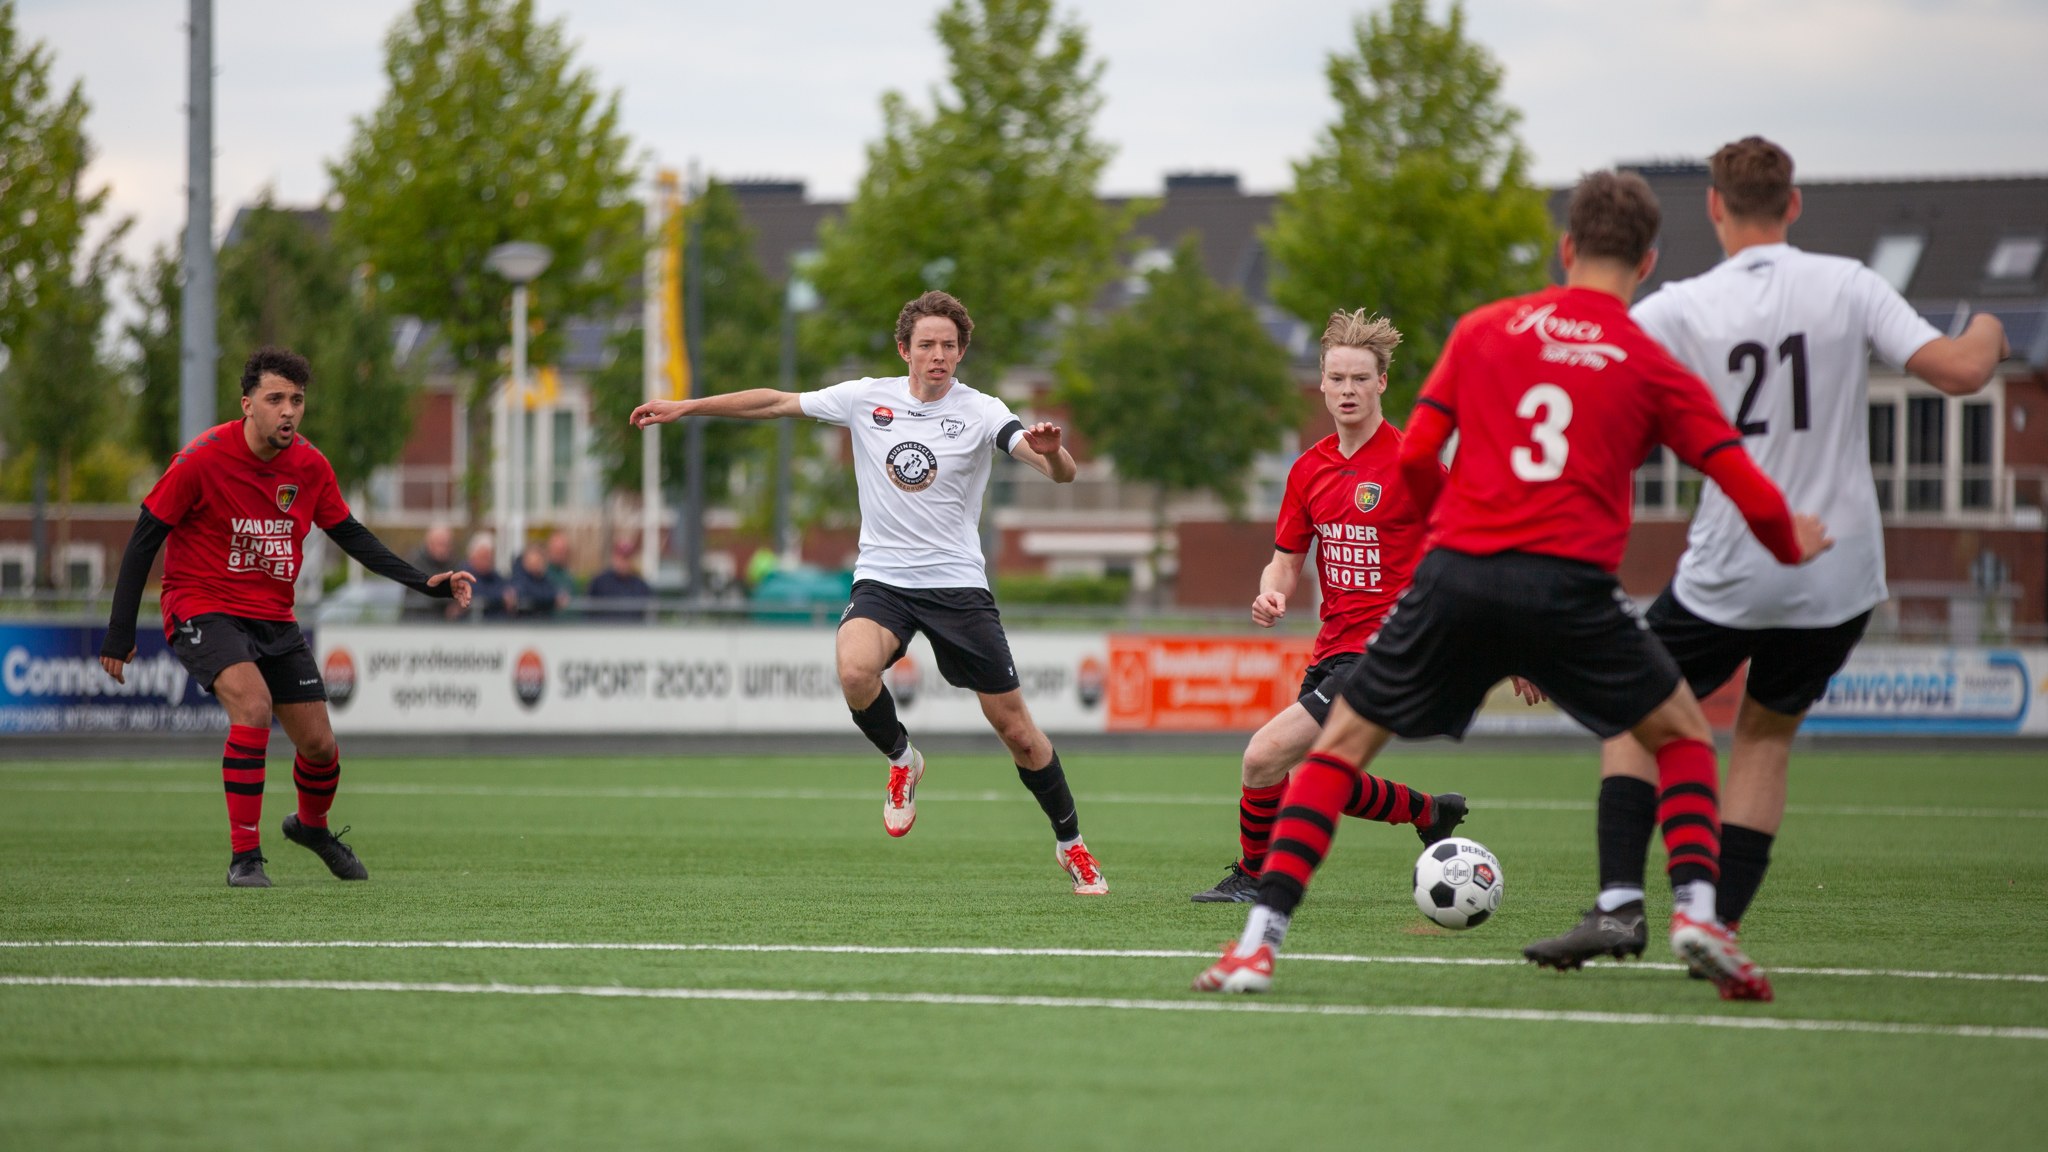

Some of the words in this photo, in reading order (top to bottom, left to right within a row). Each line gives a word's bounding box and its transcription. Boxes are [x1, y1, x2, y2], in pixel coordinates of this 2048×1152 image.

[1728, 332, 1811, 436] 21
[1510, 383, 1573, 482] 3
[889, 443, 936, 465] BUSINESSCLUB
[894, 480, 928, 491] MEERBURG
[895, 467, 927, 484] ZOETERWOUDE
[231, 518, 263, 534] VAN
[264, 520, 294, 534] DER
[1345, 524, 1379, 541] DER
[230, 534, 293, 555] LINDEN
[228, 551, 294, 577] GROEP
[559, 662, 645, 697] SPORT
[652, 662, 734, 697] 2000
[1446, 863, 1468, 881] brilliant
